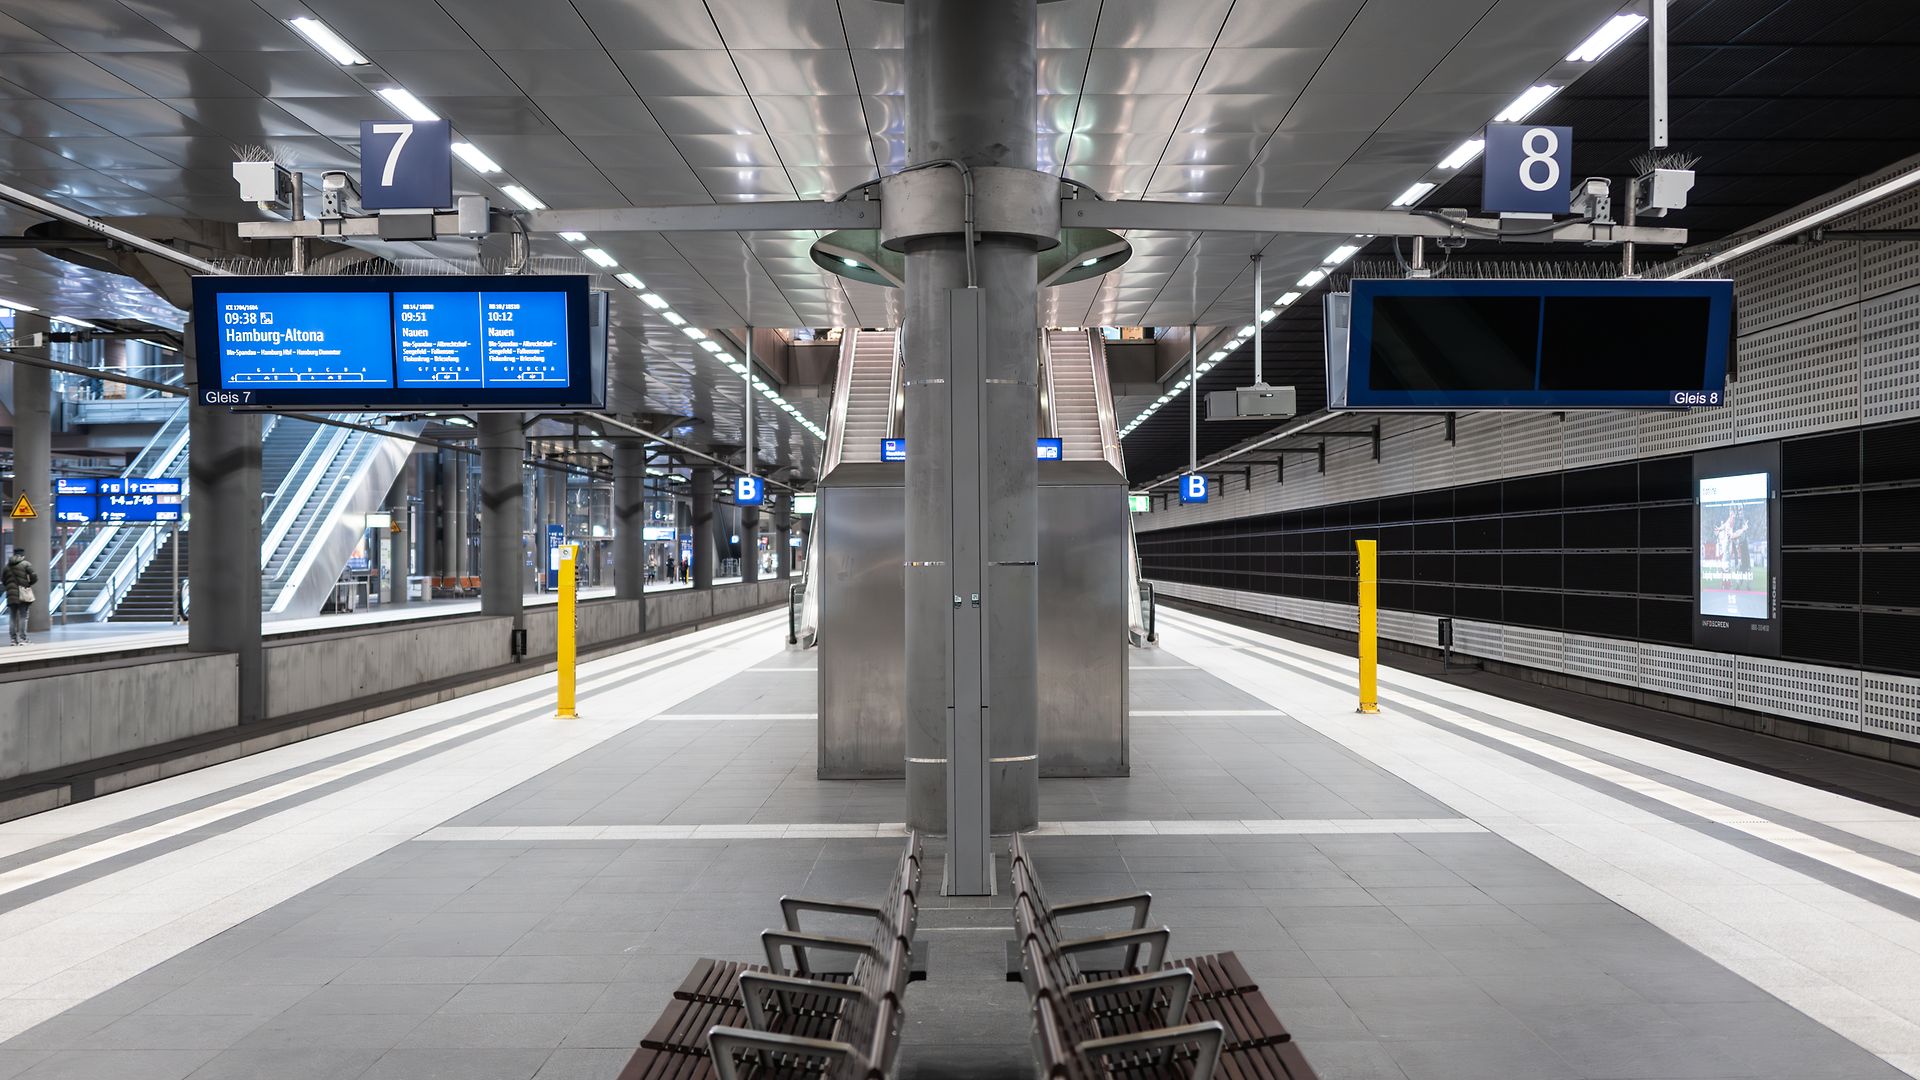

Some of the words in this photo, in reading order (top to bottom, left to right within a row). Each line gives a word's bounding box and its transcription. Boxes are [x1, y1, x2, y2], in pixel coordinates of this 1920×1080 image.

[372, 123, 413, 187] 7
[1519, 127, 1560, 192] 8
[225, 312, 257, 325] 09:38
[401, 311, 427, 322] 09:51
[488, 311, 513, 322] 10:12
[226, 328, 325, 345] Hamburg-Altona
[402, 328, 428, 337] Nauen
[488, 327, 515, 337] Nauen
[206, 391, 240, 404] Gleis
[243, 391, 251, 403] 7
[1674, 392, 1707, 404] Gleis
[1709, 392, 1718, 404] 8
[738, 477, 756, 500] B
[1189, 475, 1206, 498] B
